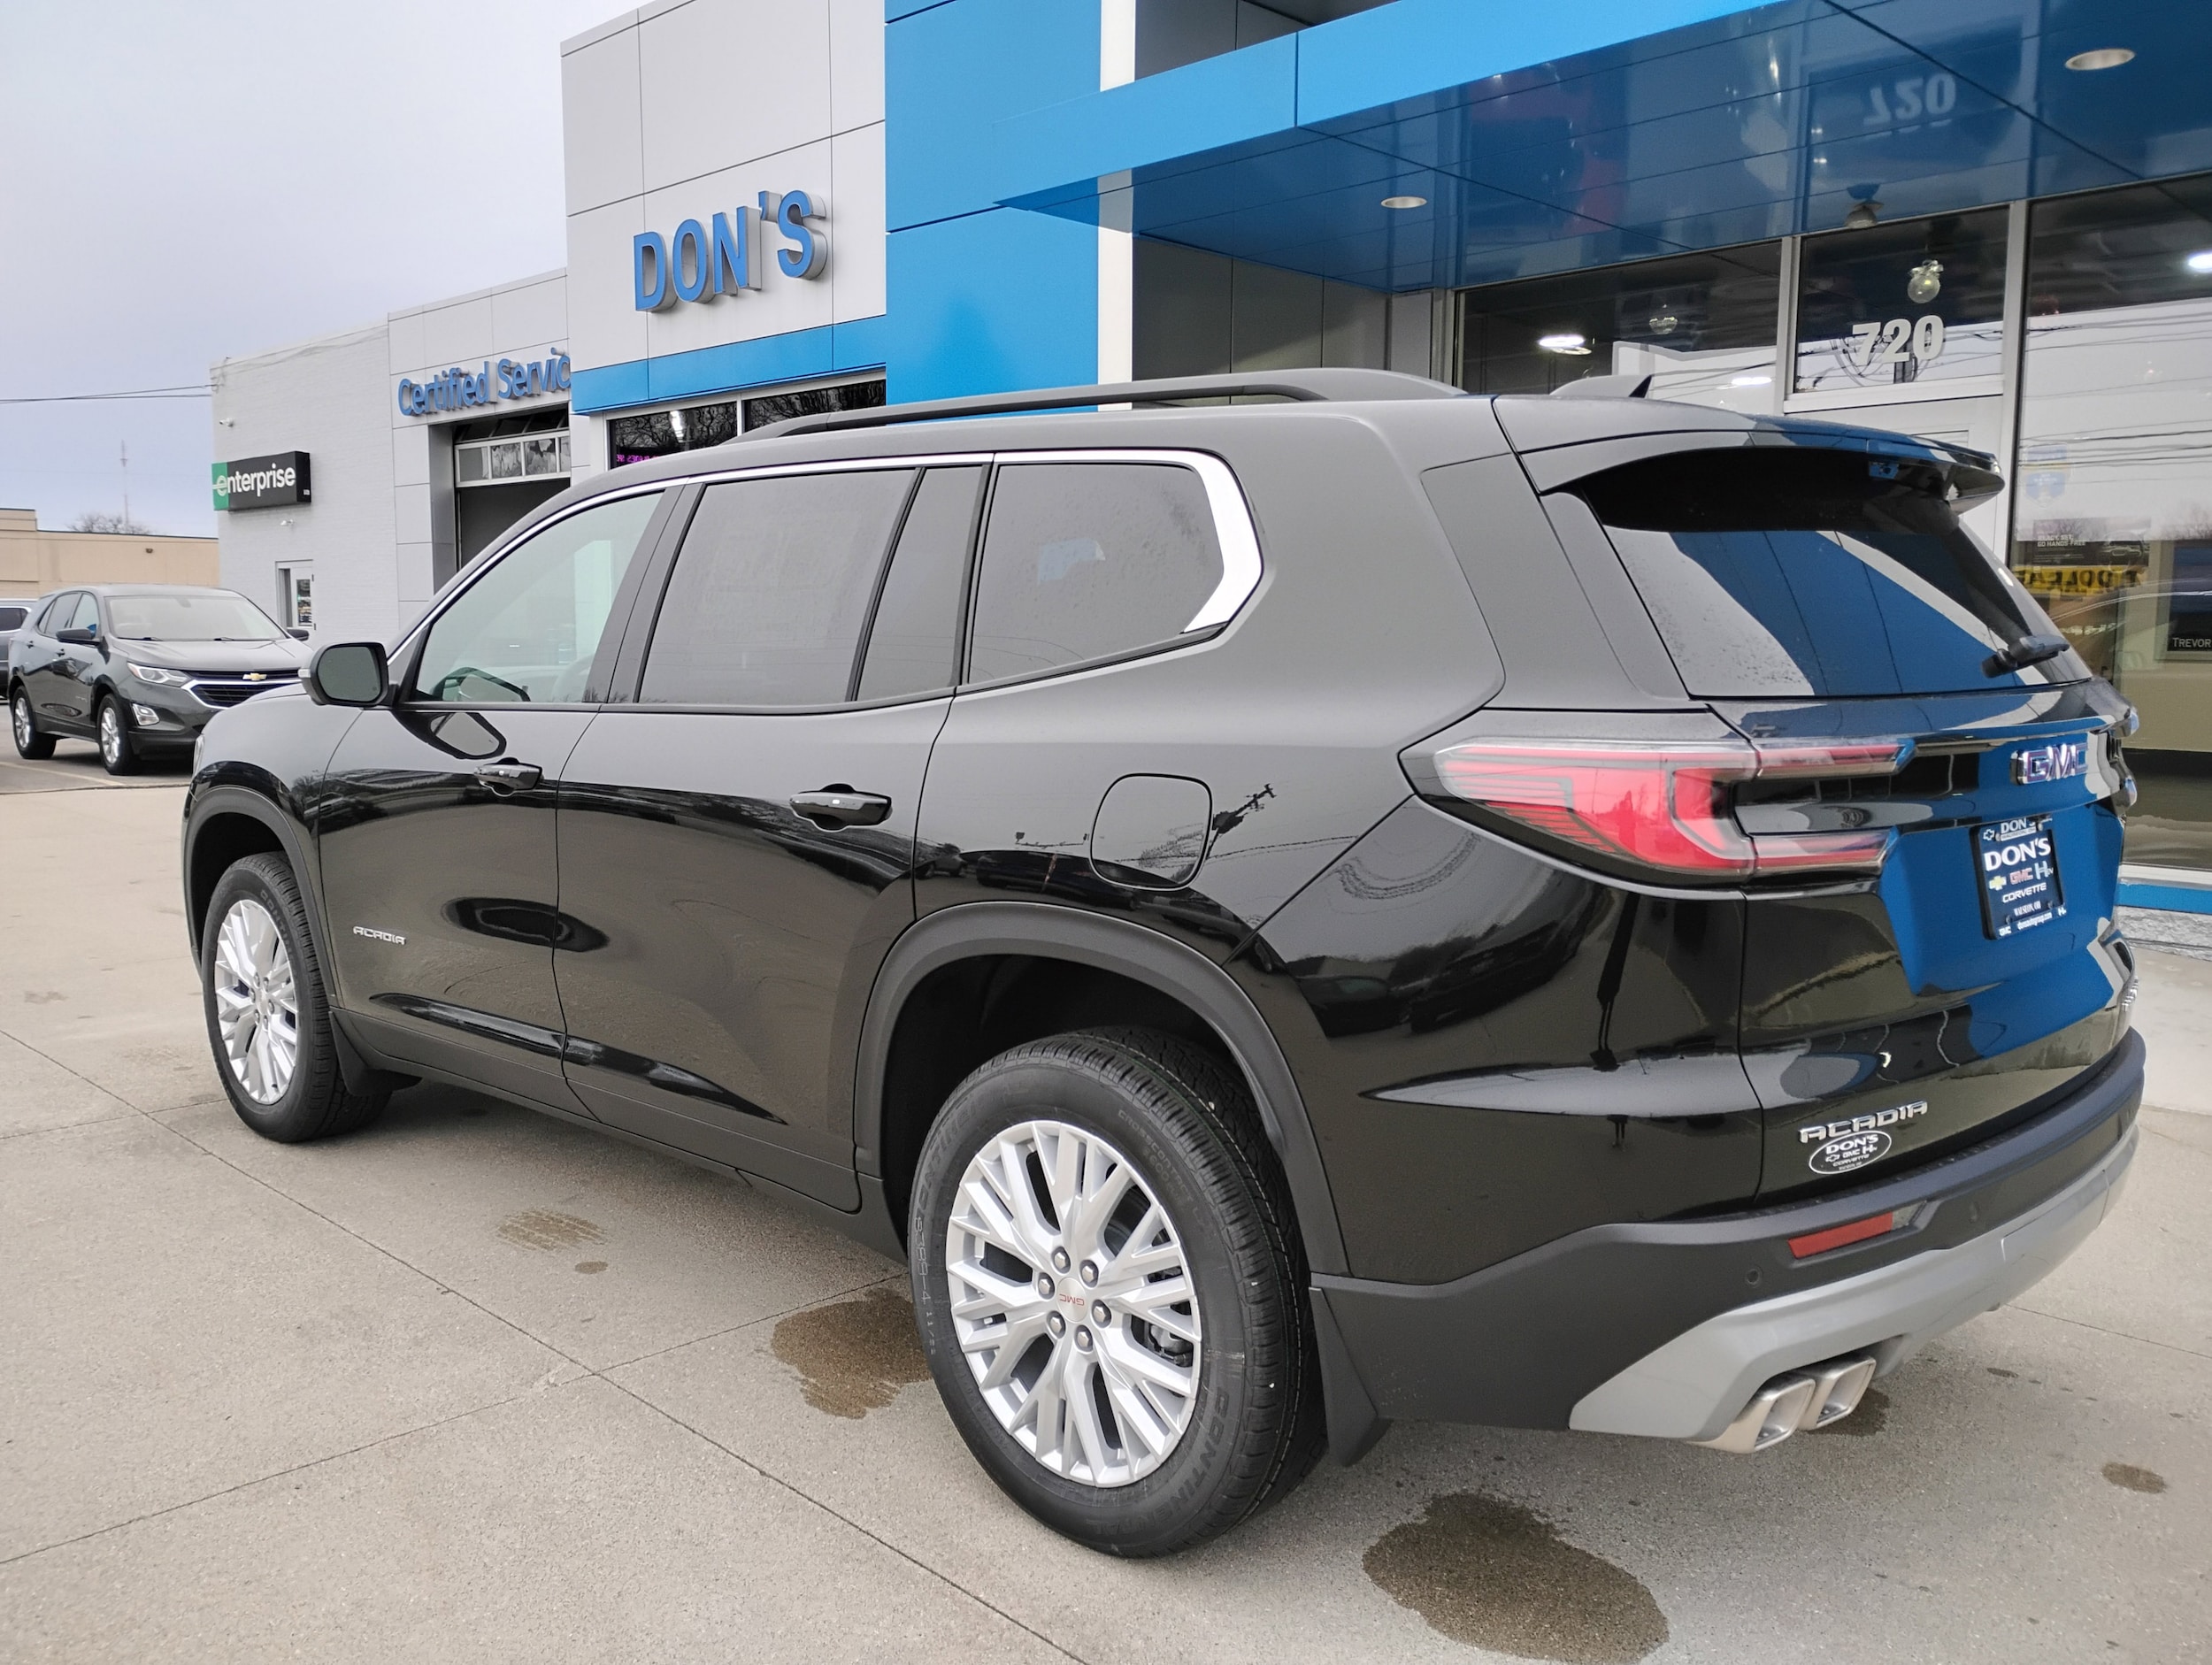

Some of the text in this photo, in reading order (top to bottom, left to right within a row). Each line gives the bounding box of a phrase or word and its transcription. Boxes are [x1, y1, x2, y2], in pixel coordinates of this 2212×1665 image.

[634, 189, 827, 312] DON'S
[1853, 314, 1945, 364] 720
[397, 347, 571, 417] Certified Servic
[212, 462, 296, 497] enterprise
[2172, 637, 2212, 648] TREVOR
[2022, 743, 2088, 785] GMC
[1984, 837, 2052, 871] DON'S
[2009, 867, 2033, 885] GMC
[2002, 882, 2047, 903] CORVETTE
[353, 925, 406, 946] ACADIA
[1799, 1100, 1928, 1143] ACADIA
[1826, 1133, 1878, 1155] DON'S
[1842, 1148, 1860, 1159] GMC
[1059, 1293, 1085, 1307] GMC
